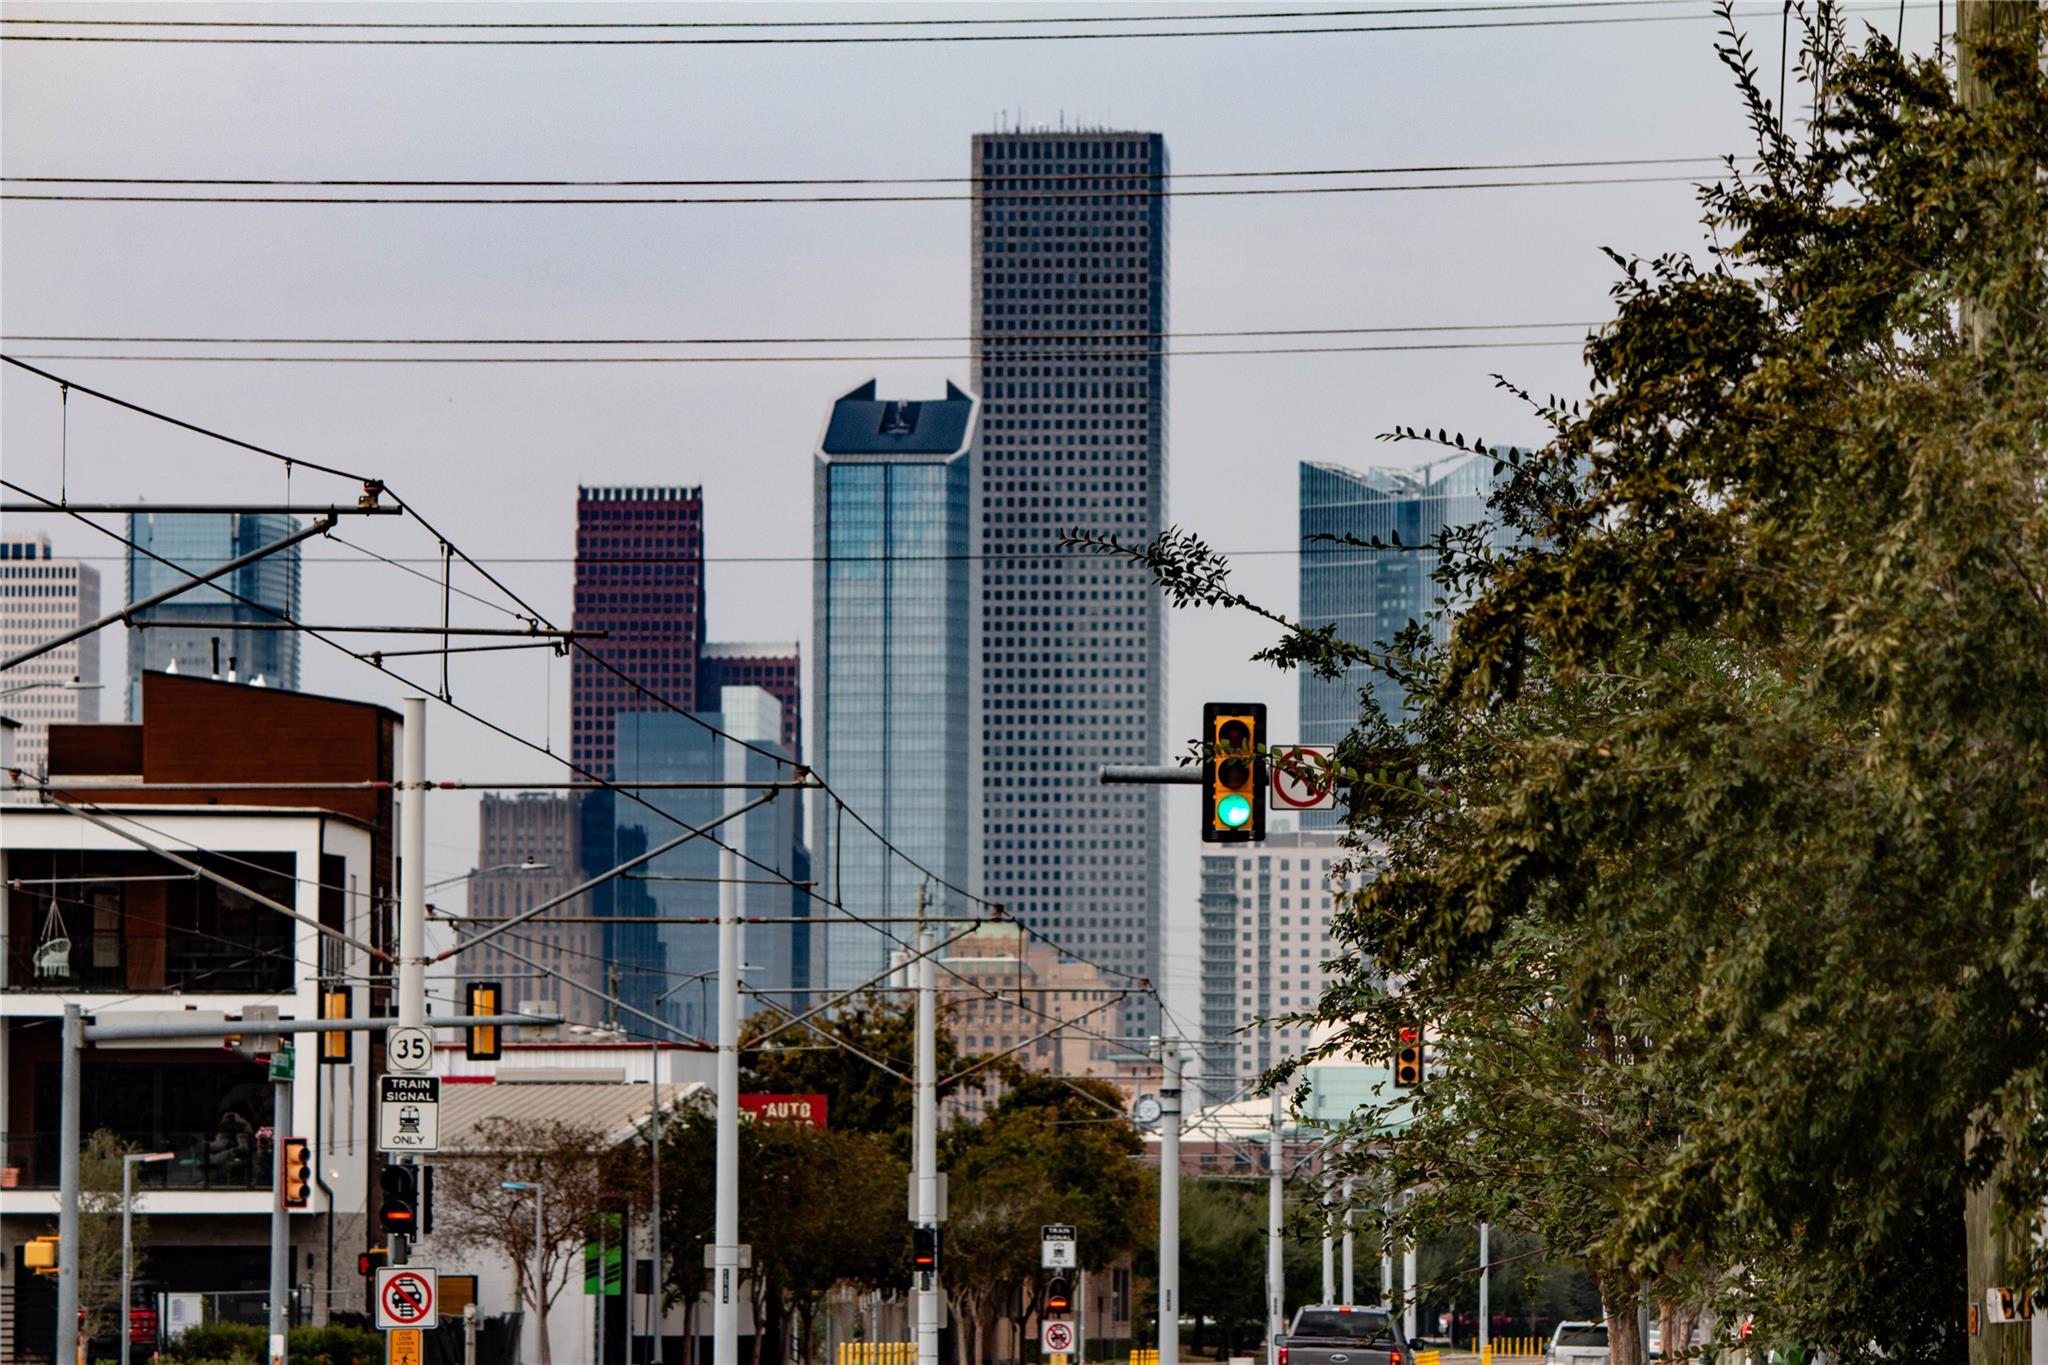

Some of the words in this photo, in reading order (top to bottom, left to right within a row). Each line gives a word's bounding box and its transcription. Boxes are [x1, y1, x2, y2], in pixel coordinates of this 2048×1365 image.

[396, 1038, 425, 1059] 35
[391, 1079, 431, 1089] TRAIN
[386, 1092, 434, 1101] SIGNAL
[766, 1102, 811, 1118] AUTO
[392, 1135, 425, 1145] ONLY
